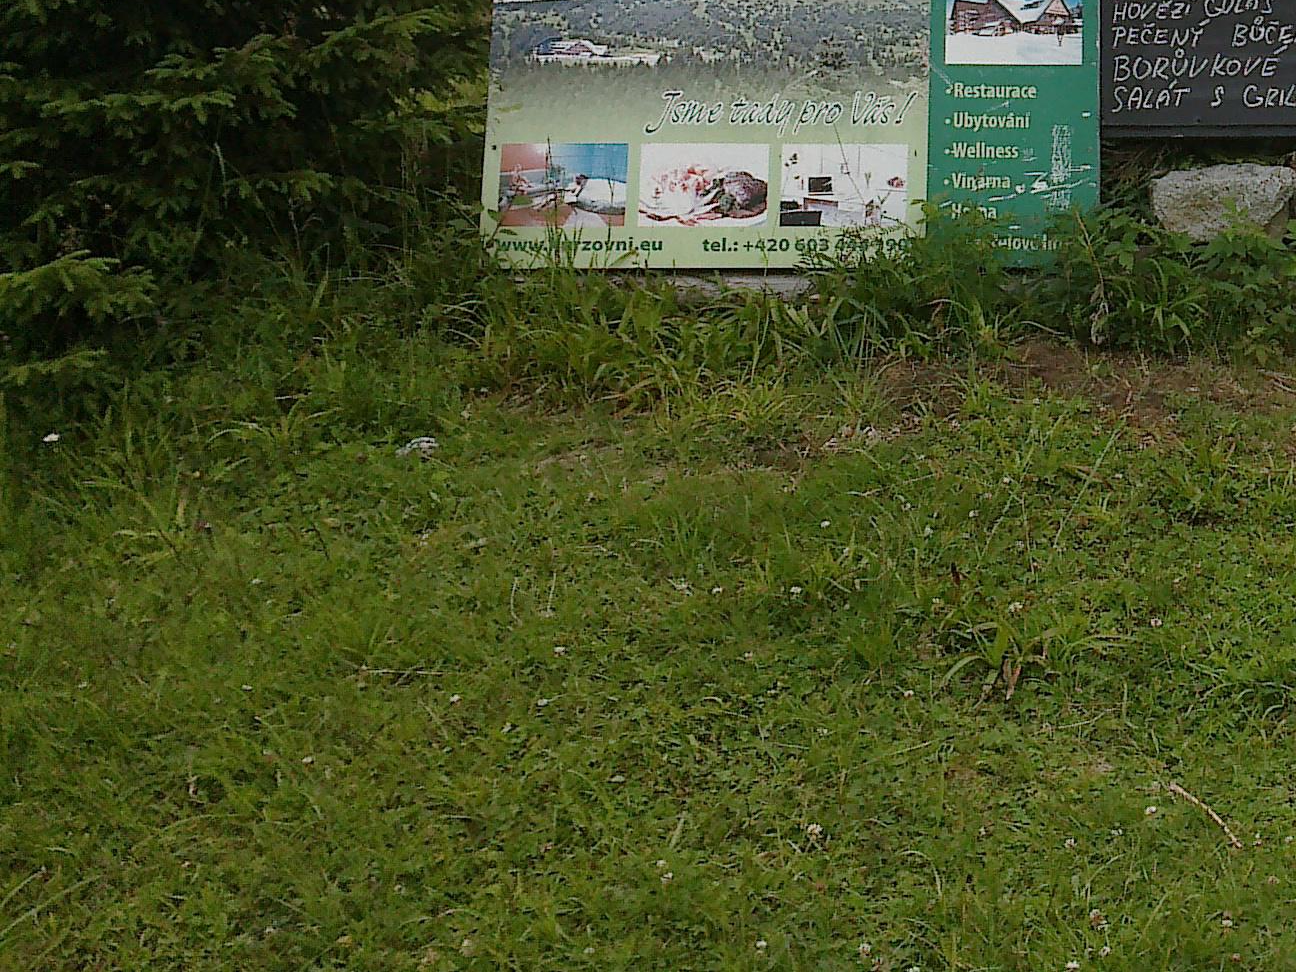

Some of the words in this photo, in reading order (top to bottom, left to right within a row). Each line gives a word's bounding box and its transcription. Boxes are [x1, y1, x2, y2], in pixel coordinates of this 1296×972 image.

[1111, 18, 1211, 48] PEČENÝ
[1114, 44, 1289, 82] BORŮVKOVÉ
[953, 82, 1038, 99] Restaurace
[1112, 79, 1191, 113] SALÁT
[1210, 86, 1225, 107] S
[645, 91, 722, 134] Jsme
[729, 93, 794, 137] tady
[792, 96, 843, 136] pro
[952, 111, 1031, 133] Ubytování
[952, 141, 1019, 160] Wellness
[702, 236, 738, 253] tel.:
[743, 238, 790, 253] +420
